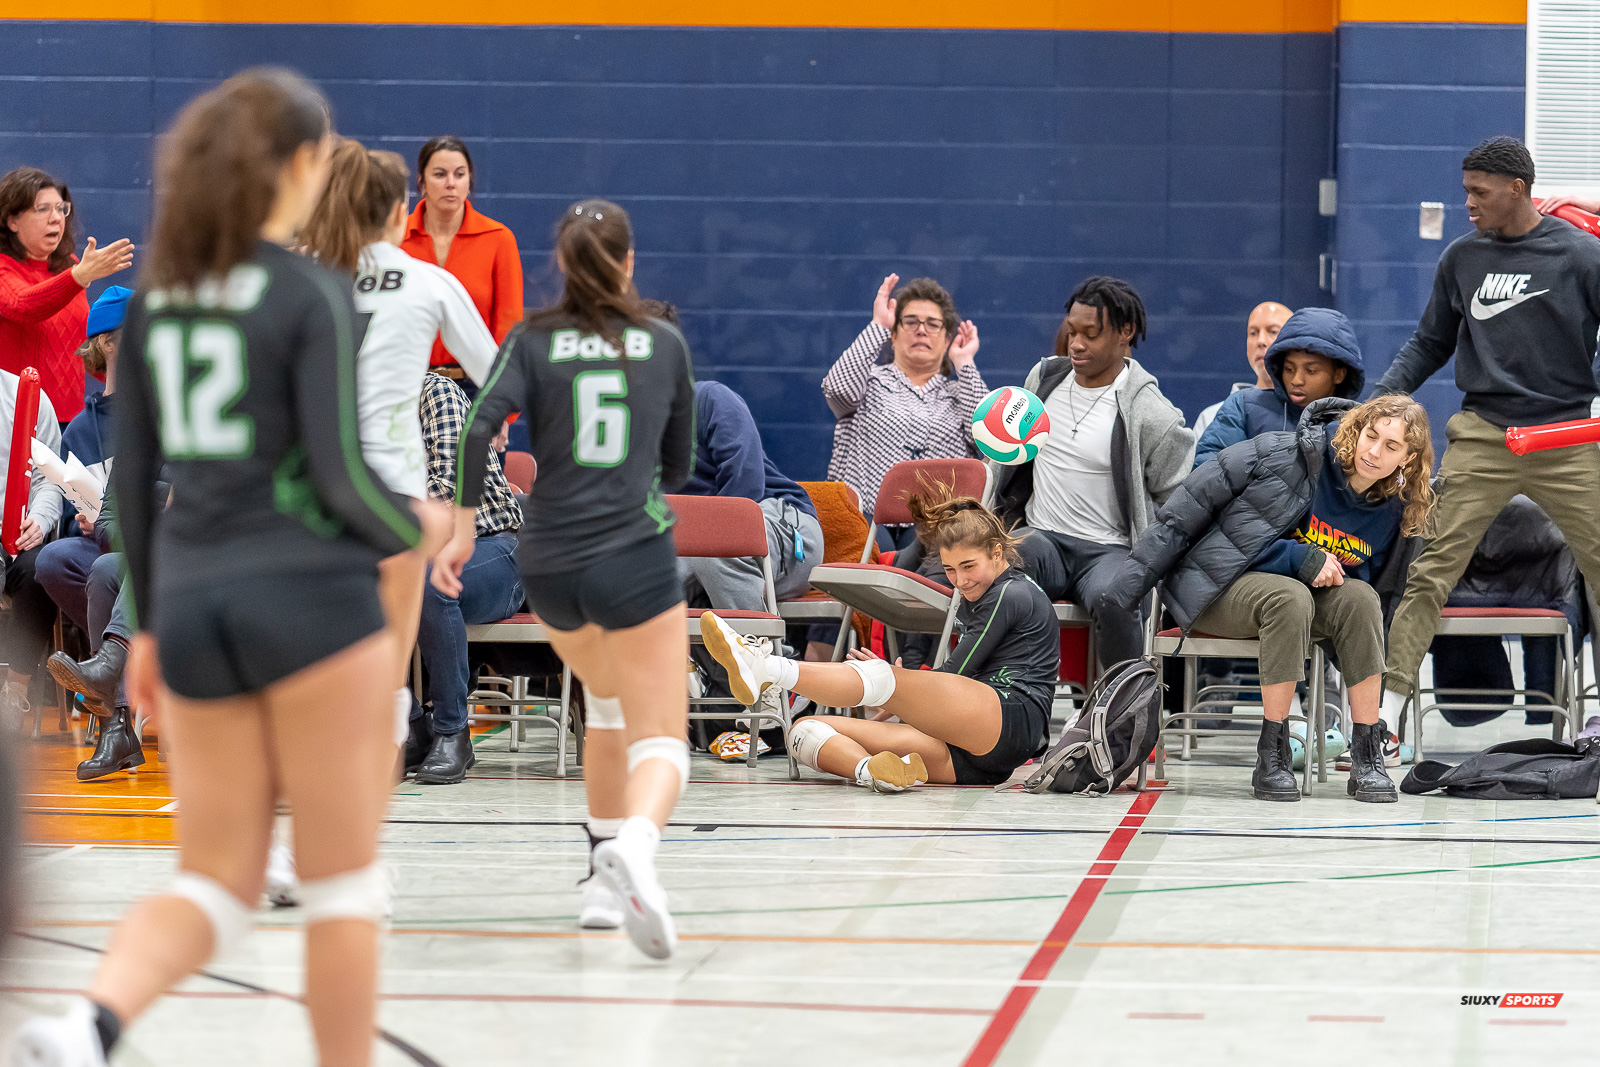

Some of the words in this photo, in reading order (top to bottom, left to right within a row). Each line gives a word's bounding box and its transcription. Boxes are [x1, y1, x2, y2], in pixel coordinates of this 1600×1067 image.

[354, 270, 404, 294] eB
[1479, 273, 1531, 299] NIKE
[146, 319, 255, 460] 12
[572, 369, 631, 468] 6
[1005, 397, 1027, 424] molten
